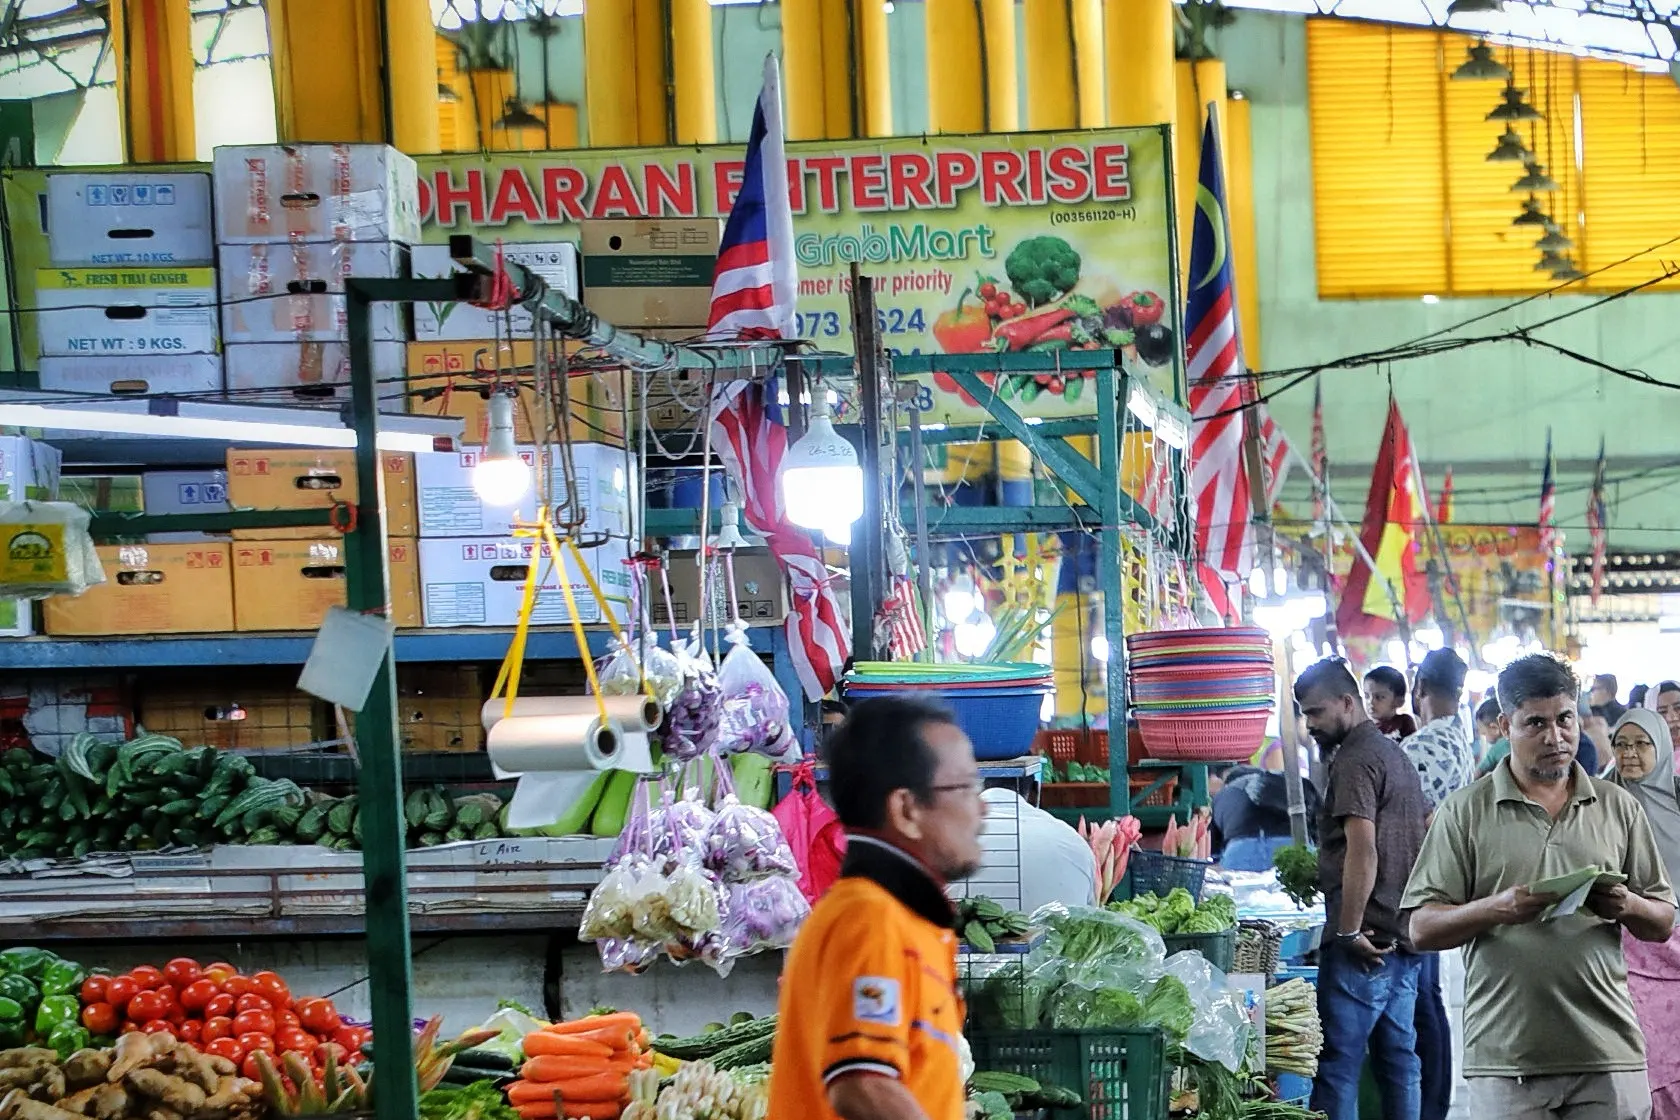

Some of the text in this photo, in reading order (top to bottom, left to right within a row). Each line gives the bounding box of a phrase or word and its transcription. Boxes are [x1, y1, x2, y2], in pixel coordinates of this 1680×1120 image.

[1050, 206, 1136, 225] (003561120-H)
[795, 223, 996, 267] GrabMart
[92, 254, 113, 264] NET
[86, 273, 188, 285] FRESH THAI GINGER
[893, 269, 953, 296] priority
[68, 338, 98, 350] NET
[101, 338, 125, 350] WT
[137, 338, 146, 349] 9
[151, 337, 187, 349] KGS.
